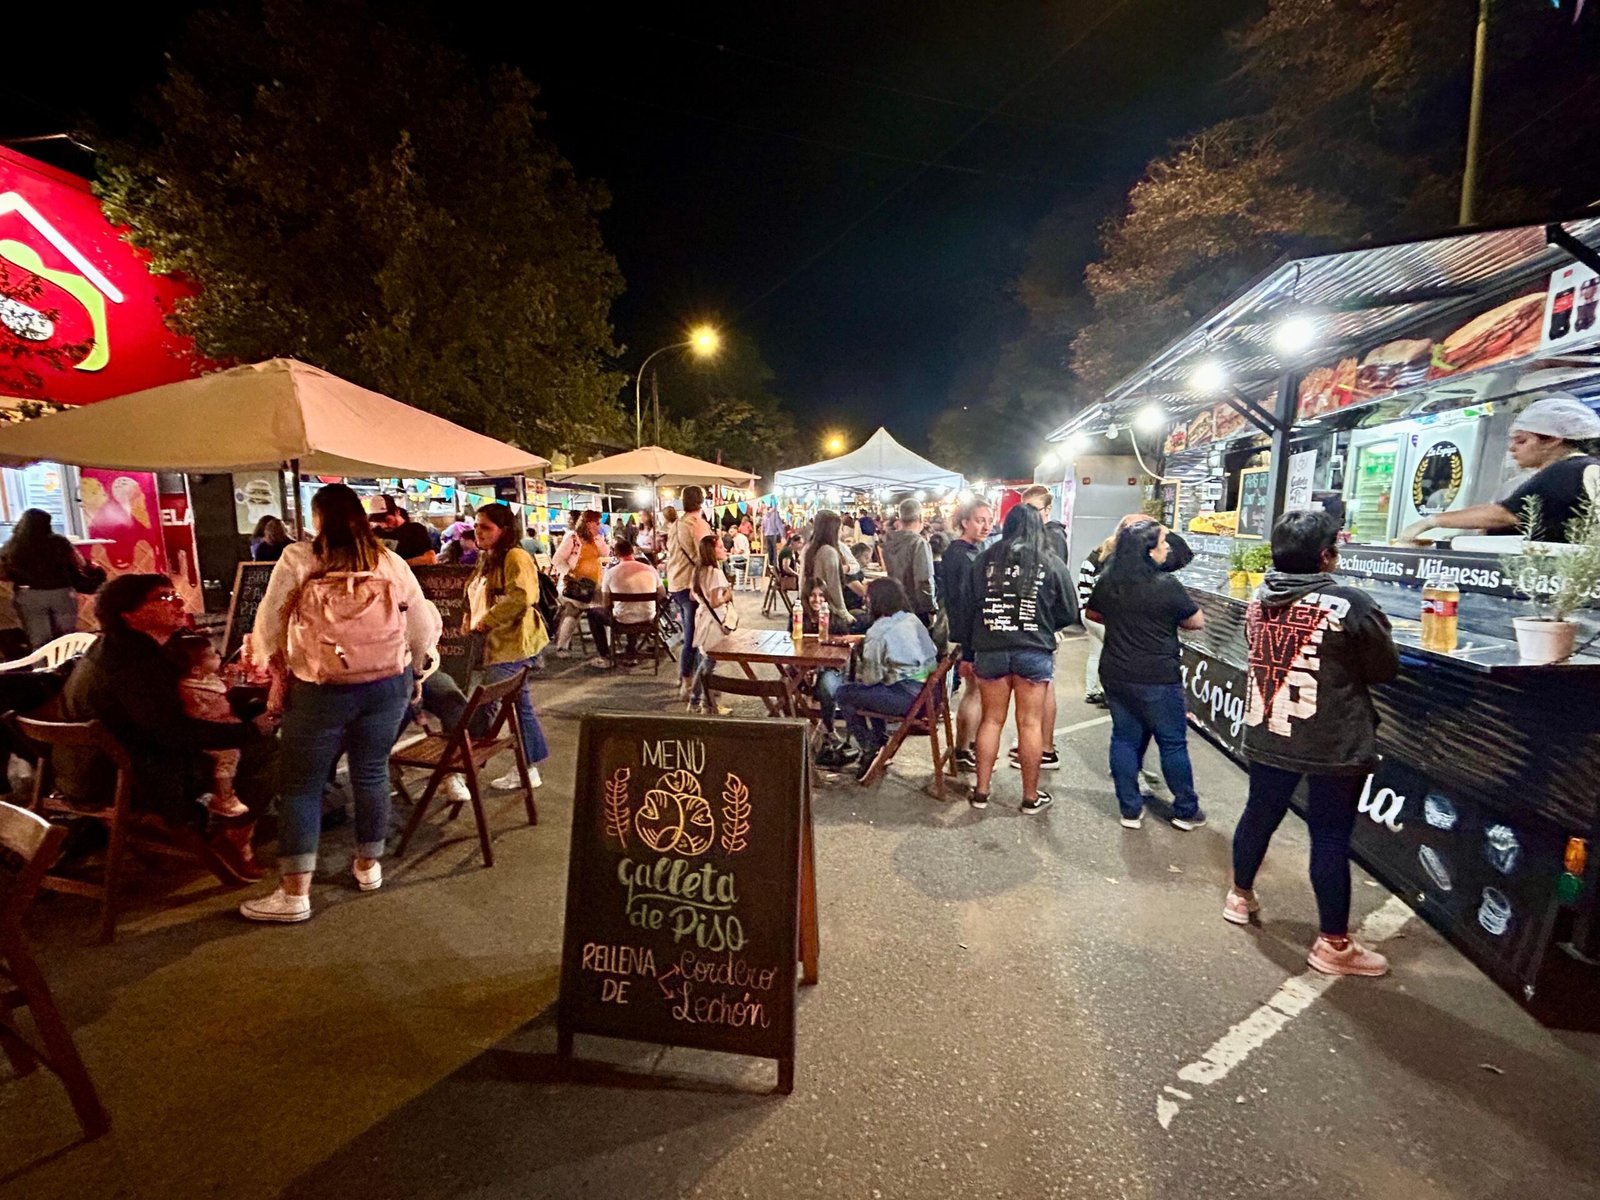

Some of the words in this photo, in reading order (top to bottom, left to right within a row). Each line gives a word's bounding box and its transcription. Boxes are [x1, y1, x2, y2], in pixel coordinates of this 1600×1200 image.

[1415, 558, 1500, 588] Milanesas
[1191, 660, 1244, 738] Espig
[629, 904, 663, 929] de
[582, 942, 657, 977] RELLENA
[679, 950, 779, 990] Cordero
[601, 978, 631, 1004] DE
[672, 980, 771, 1029] Lechón
